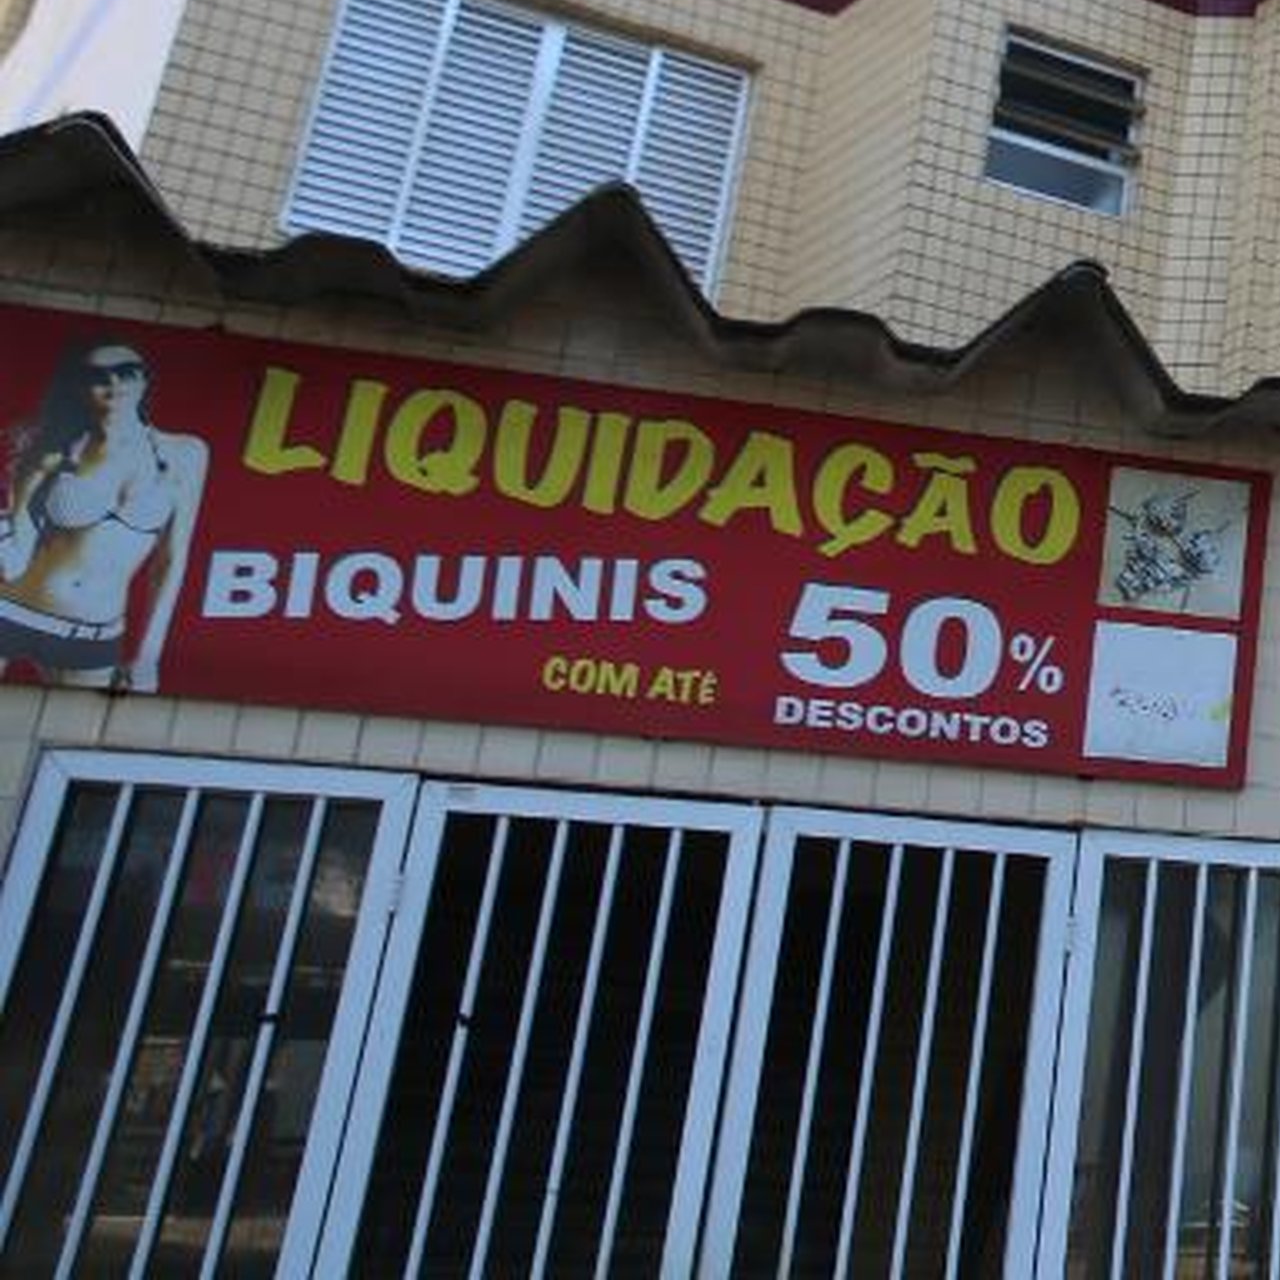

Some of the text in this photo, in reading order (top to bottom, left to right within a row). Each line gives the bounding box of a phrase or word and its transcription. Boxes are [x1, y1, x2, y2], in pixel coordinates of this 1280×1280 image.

[243, 366, 1080, 566] LIQUIDAÇÃO
[201, 549, 708, 624] BIQUINIS
[541, 654, 637, 698] COM
[780, 583, 1064, 700] 50%
[773, 694, 1051, 750] DESCONTOS
